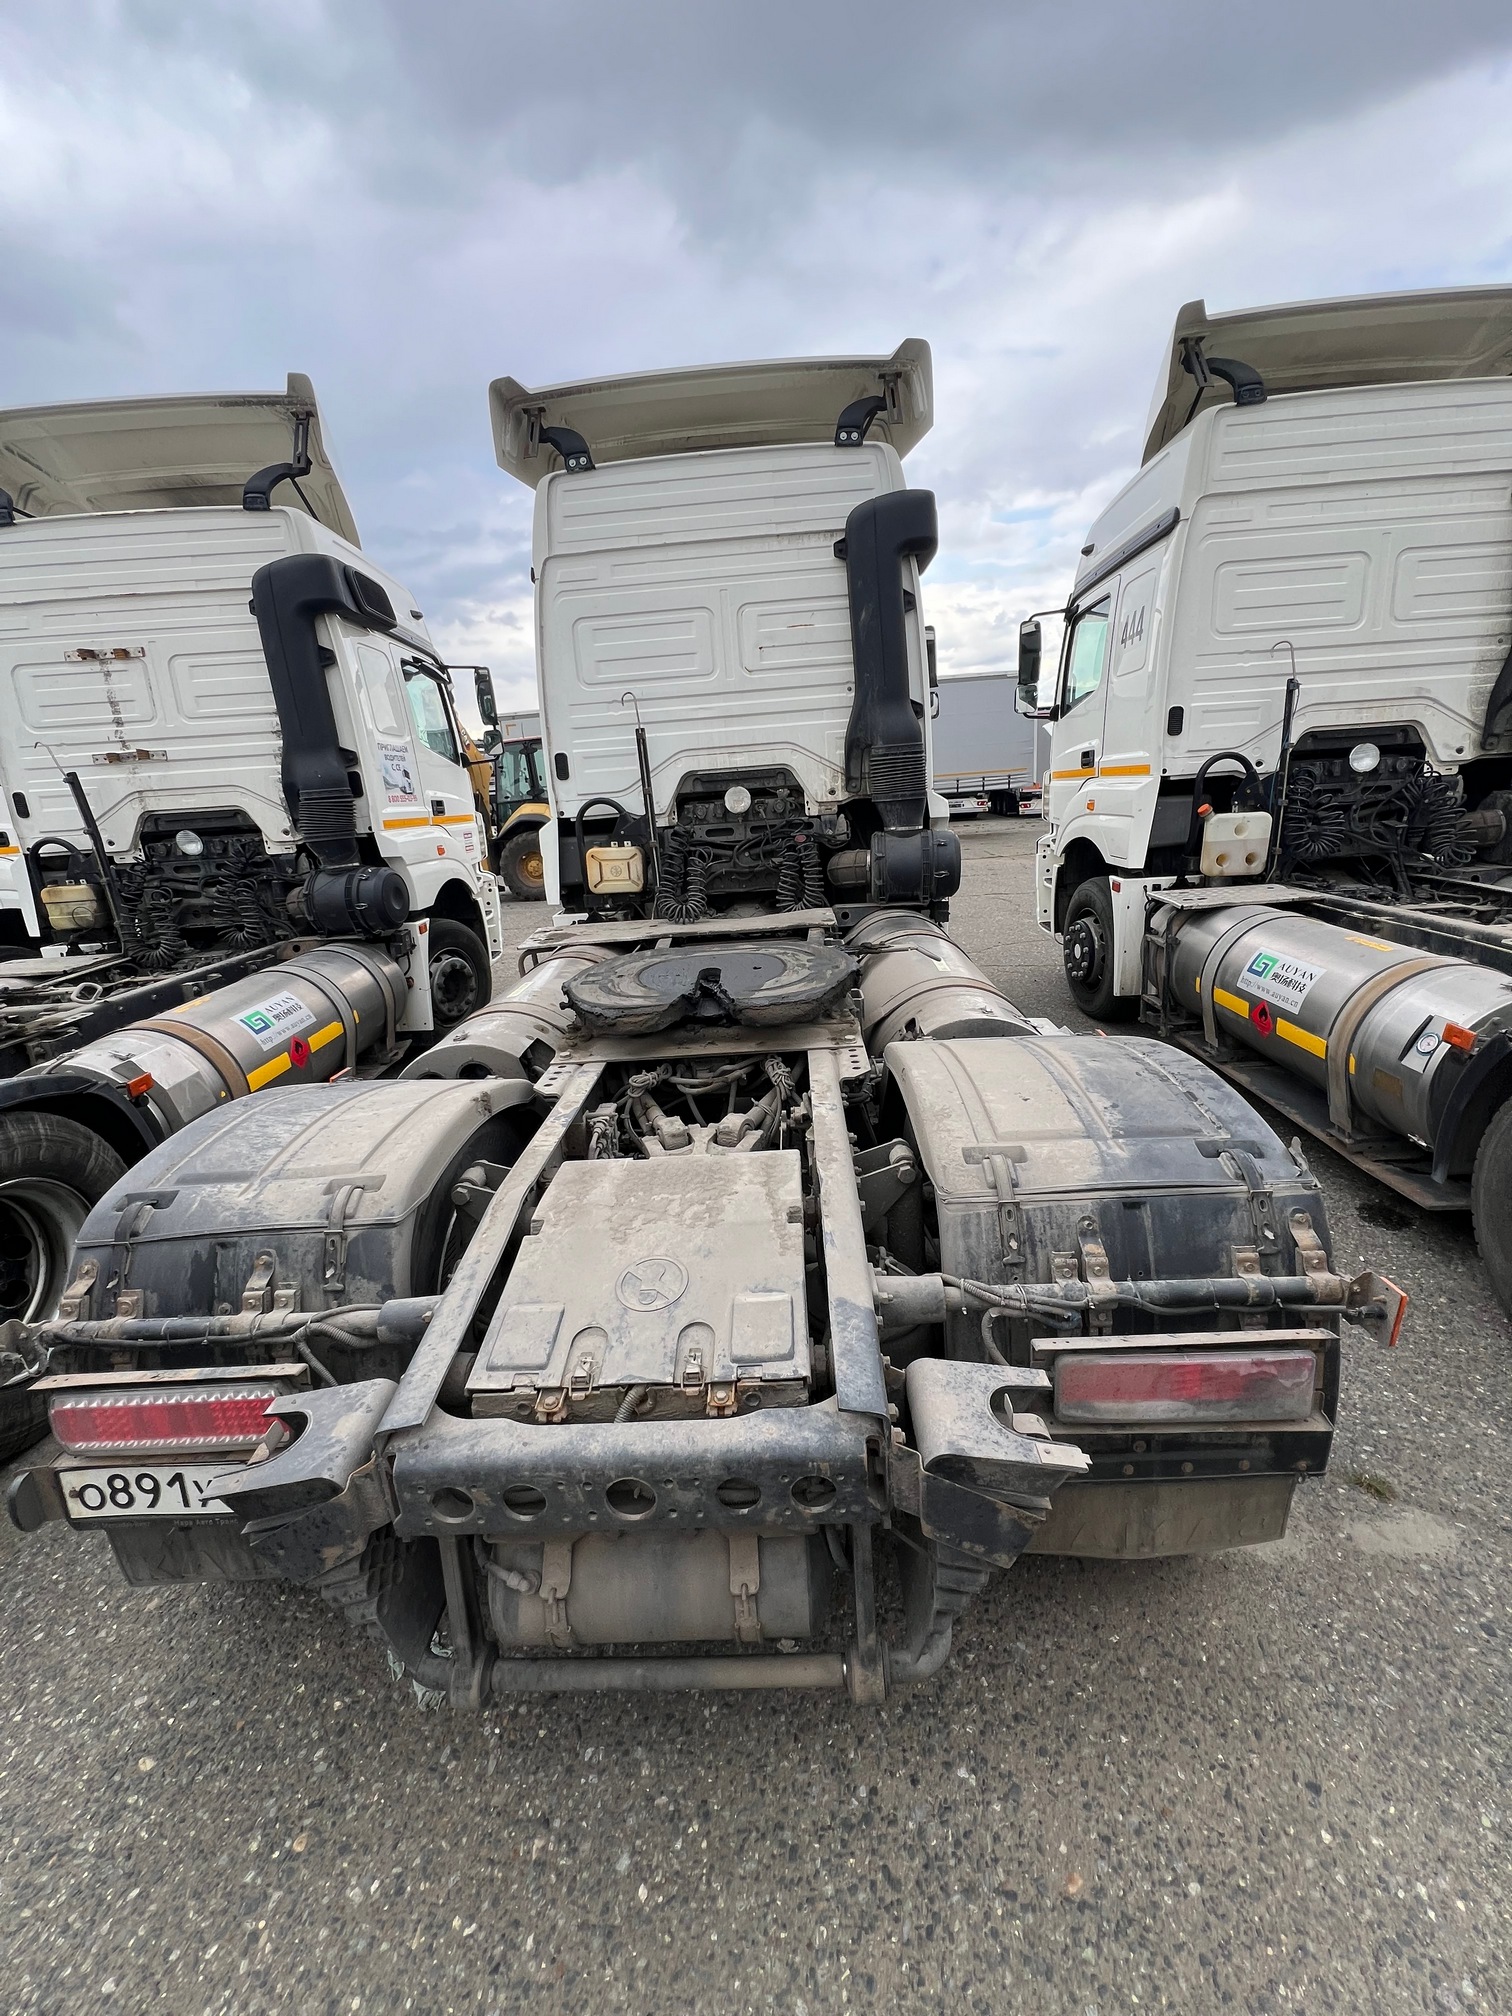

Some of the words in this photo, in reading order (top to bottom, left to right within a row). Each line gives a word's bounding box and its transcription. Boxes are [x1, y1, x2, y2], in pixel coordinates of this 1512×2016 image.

[1120, 605, 1145, 649] 444
[377, 742, 409, 753] ПРИГЛАШАЕМ
[384, 753, 406, 762] ВОДИТЕЛЕЙ
[1278, 962, 1317, 982] AUYAN
[264, 996, 295, 1013] AUYAN
